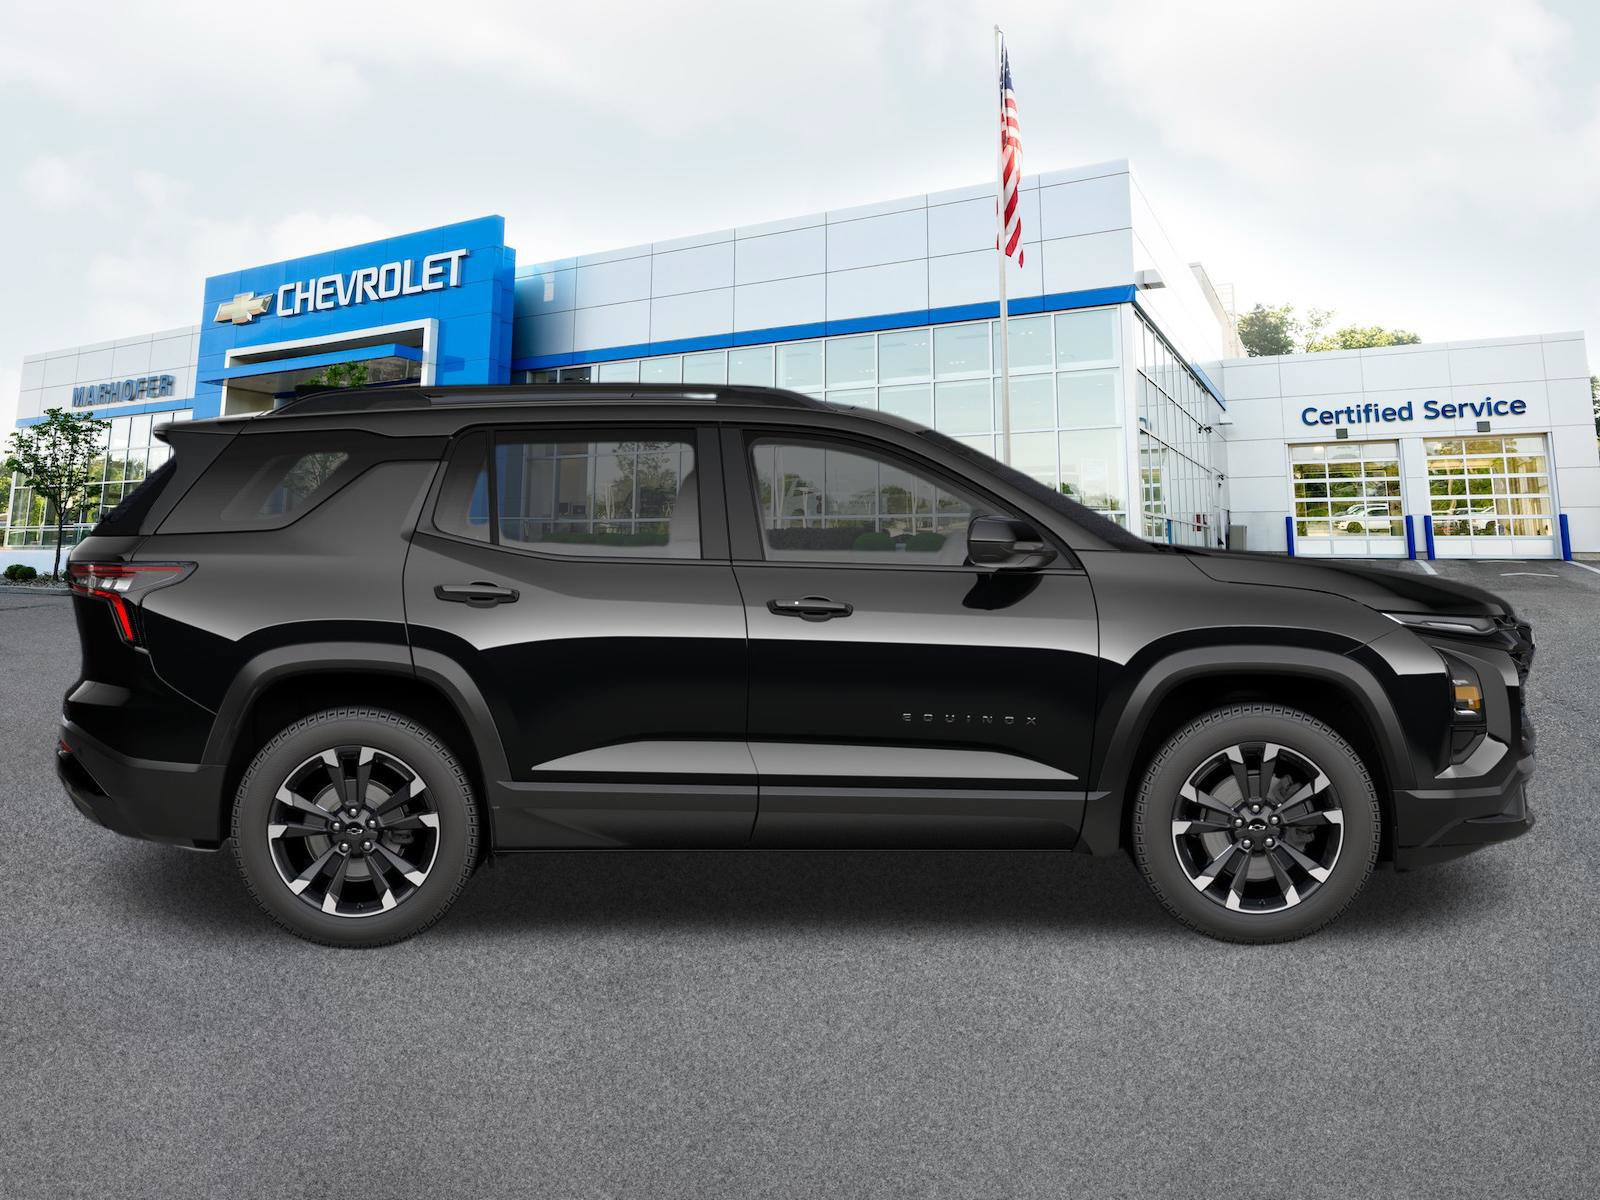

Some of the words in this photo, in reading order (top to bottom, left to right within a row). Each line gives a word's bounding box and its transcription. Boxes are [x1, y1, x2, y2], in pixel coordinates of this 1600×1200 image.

[276, 248, 469, 316] CHEVROLET
[72, 374, 175, 407] MARHOFER
[1301, 401, 1414, 426] Certified
[1423, 396, 1527, 420] Service
[902, 713, 1036, 725] EQUINOX
